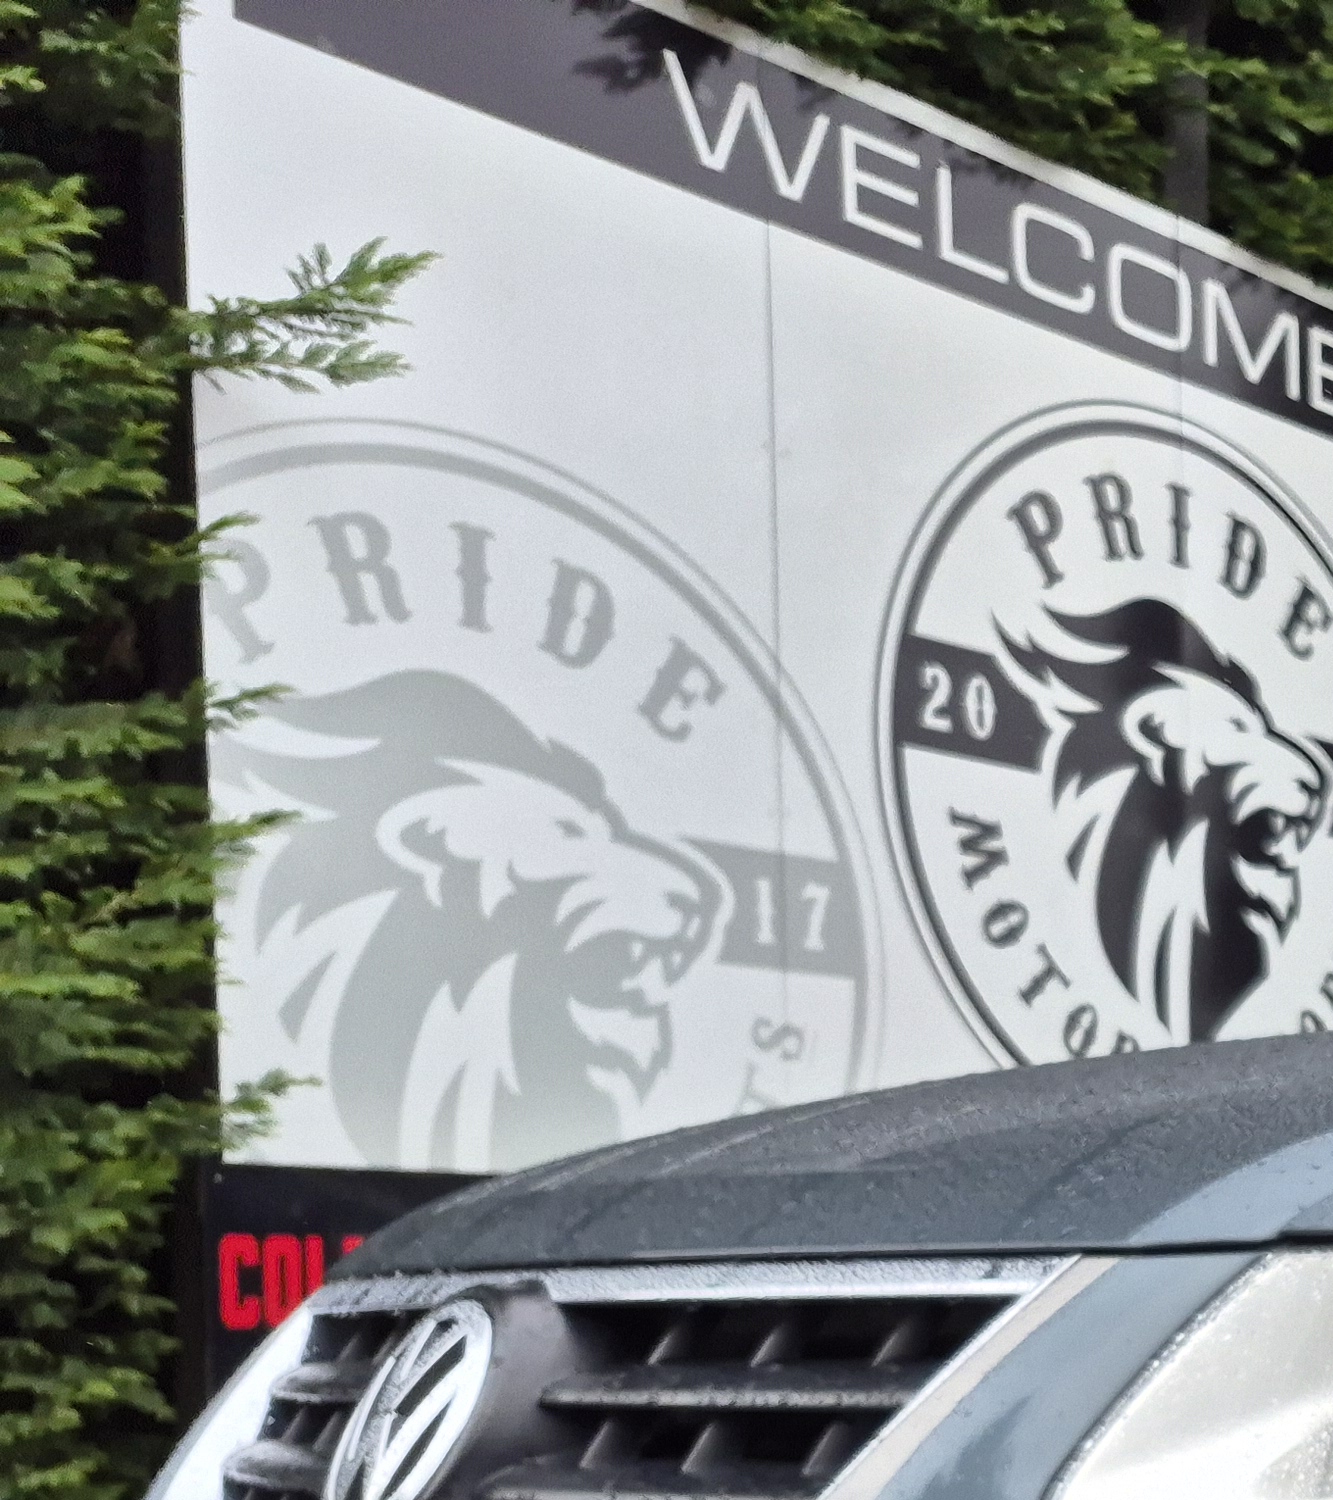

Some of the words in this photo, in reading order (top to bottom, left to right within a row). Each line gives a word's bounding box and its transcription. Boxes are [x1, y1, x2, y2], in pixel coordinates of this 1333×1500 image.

[919, 667, 997, 741] 20
[755, 878, 828, 952] 17
[220, 1233, 364, 1330] COL
